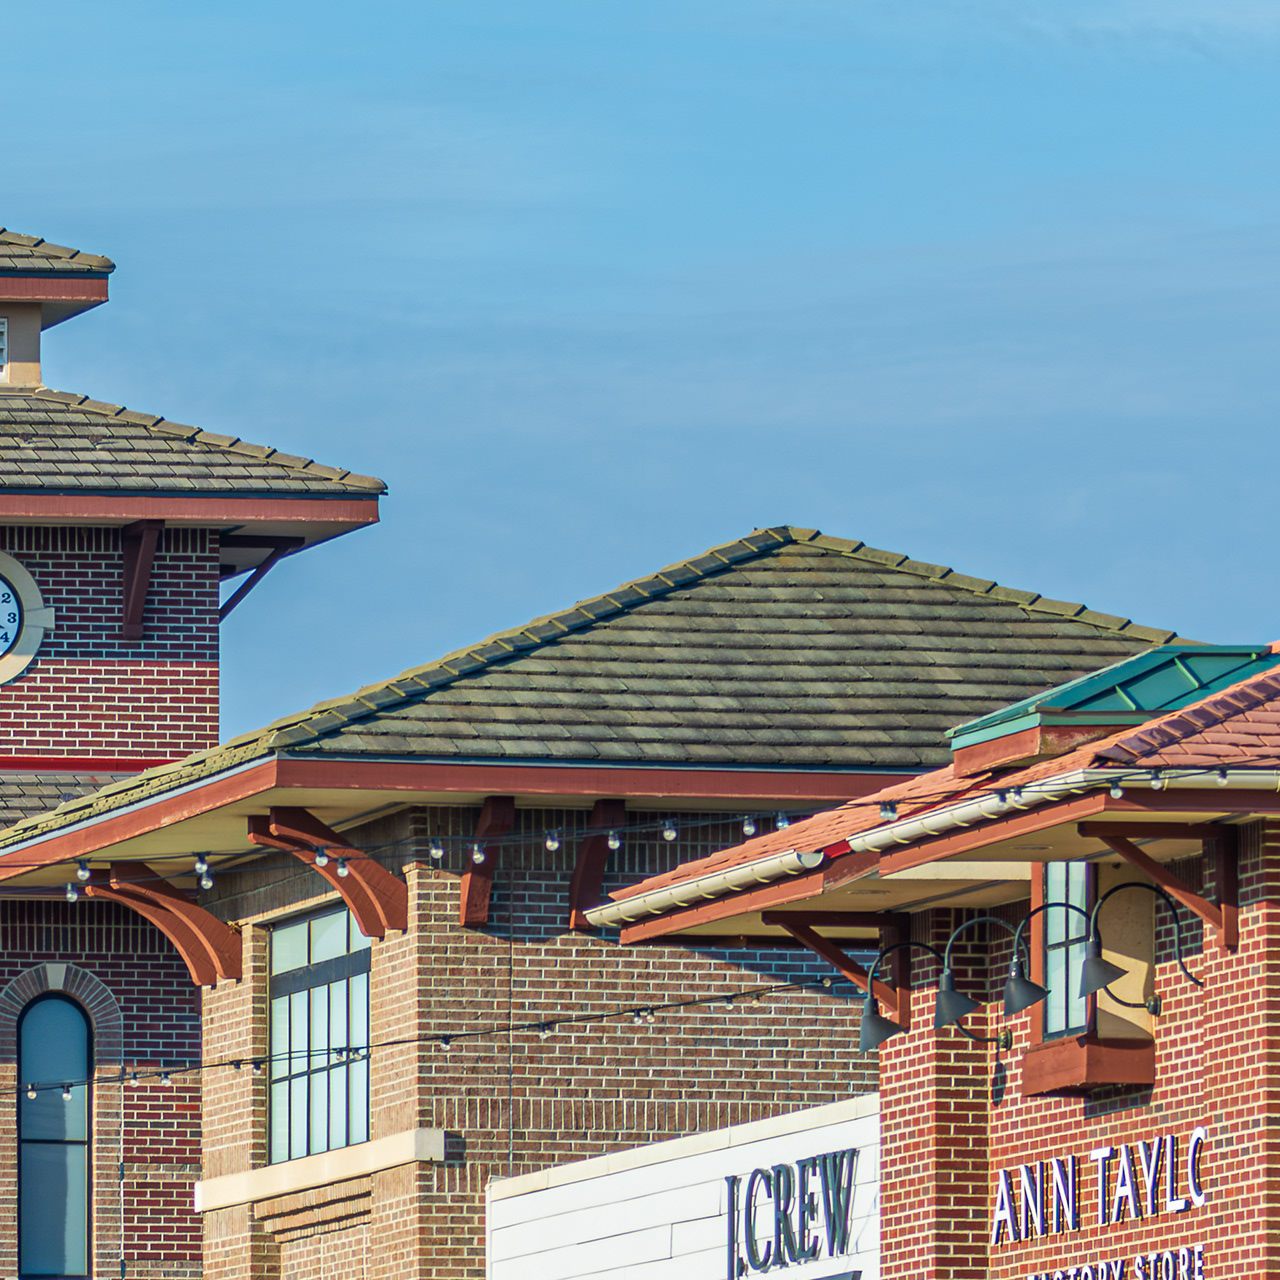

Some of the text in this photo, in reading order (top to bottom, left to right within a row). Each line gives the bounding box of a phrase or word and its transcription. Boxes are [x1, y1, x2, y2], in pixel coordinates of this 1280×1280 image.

[1, 592, 11, 604] 2
[7, 612, 17, 623] 3
[0, 631, 10, 643] 4
[991, 1126, 1206, 1246] ANN TAYLO
